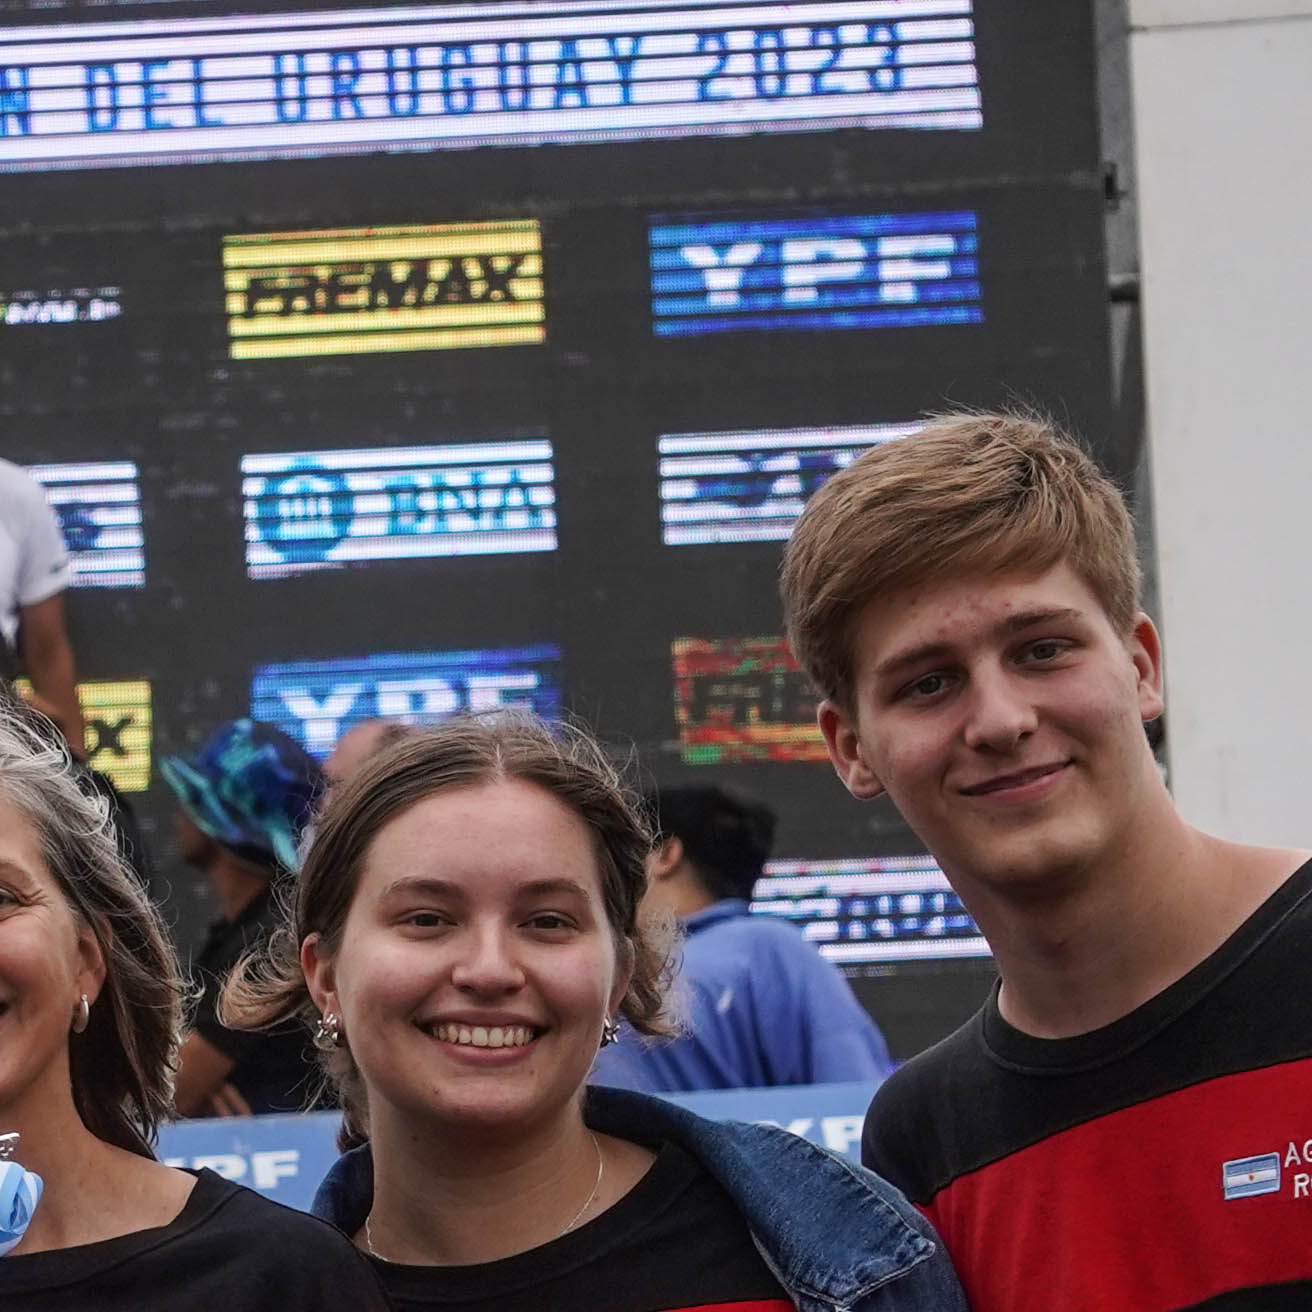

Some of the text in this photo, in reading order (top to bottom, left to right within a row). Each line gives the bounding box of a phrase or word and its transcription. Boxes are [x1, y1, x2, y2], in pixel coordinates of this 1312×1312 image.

[86, 58, 225, 132] DEL
[273, 36, 643, 125] URUGUAY
[696, 26, 906, 103] 2023
[679, 234, 957, 306] YPF
